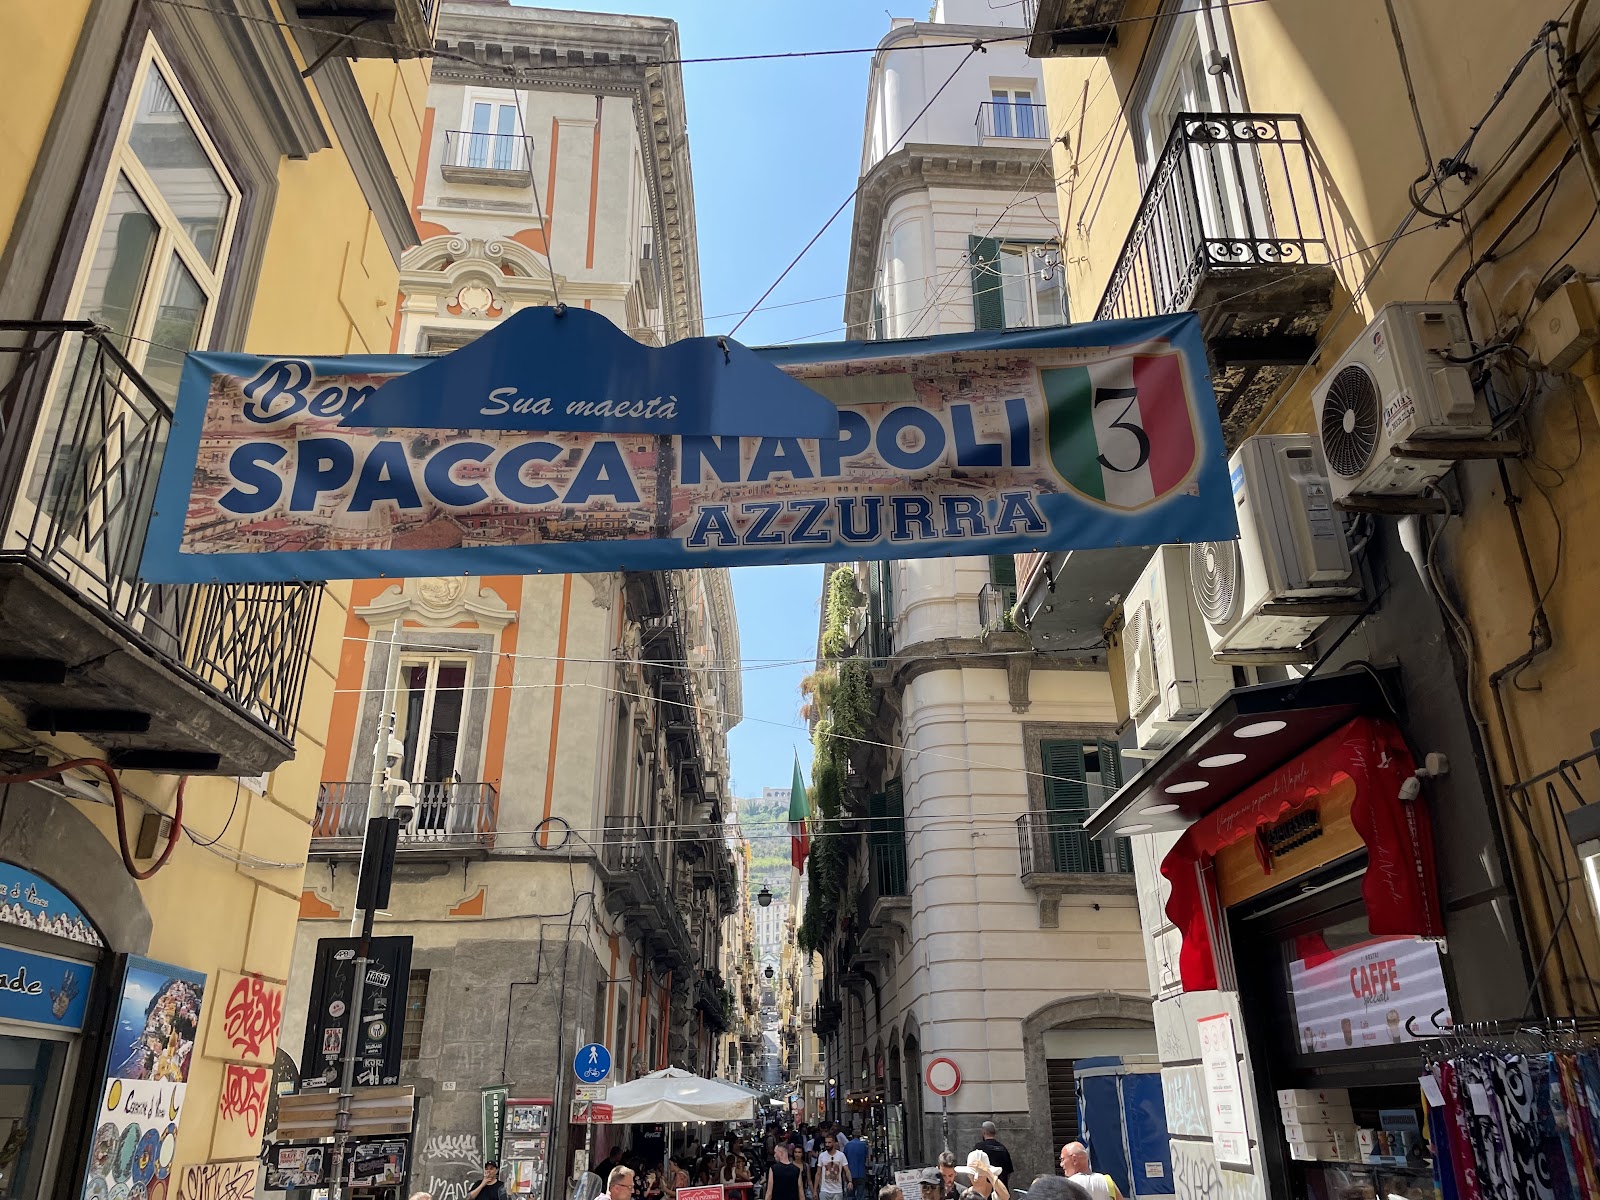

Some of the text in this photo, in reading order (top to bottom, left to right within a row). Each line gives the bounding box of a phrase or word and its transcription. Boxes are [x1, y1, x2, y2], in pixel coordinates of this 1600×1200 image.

[480, 387, 679, 420] Sua maestà
[1092, 387, 1152, 473] 3
[218, 398, 1031, 514] SPACCA NAPOLI
[686, 490, 1047, 549] AZZURRA
